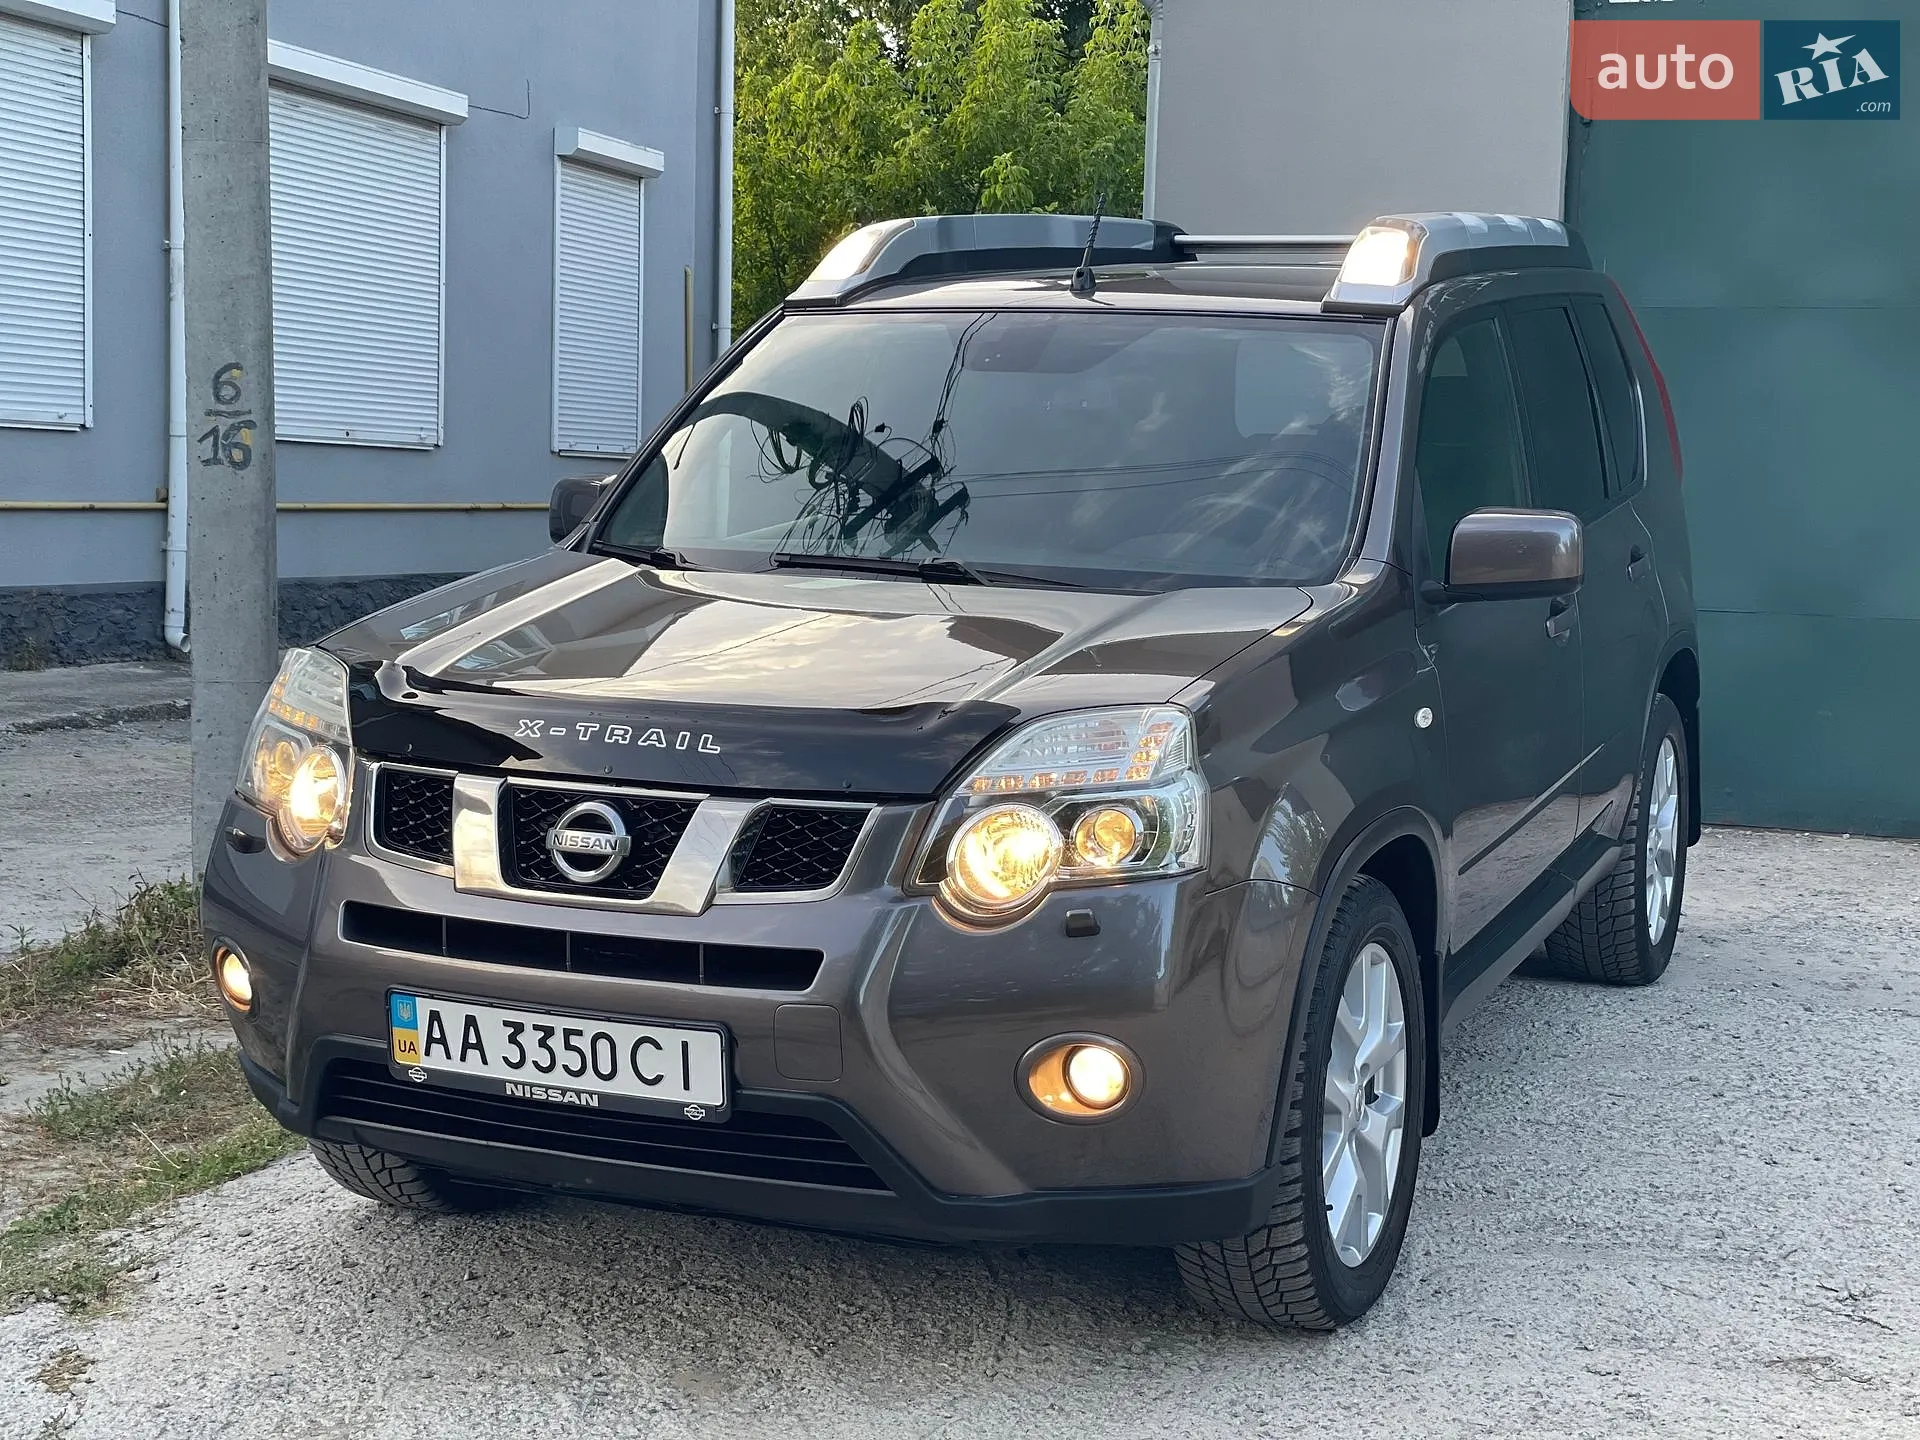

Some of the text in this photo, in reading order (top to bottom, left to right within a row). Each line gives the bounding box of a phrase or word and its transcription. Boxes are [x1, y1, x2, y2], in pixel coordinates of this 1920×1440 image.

[212, 362, 243, 405] 6
[515, 719, 721, 754] X-TRAIL
[552, 834, 619, 852] NISSAN
[397, 1038, 418, 1057] UA
[504, 1082, 599, 1108] NISSAN
